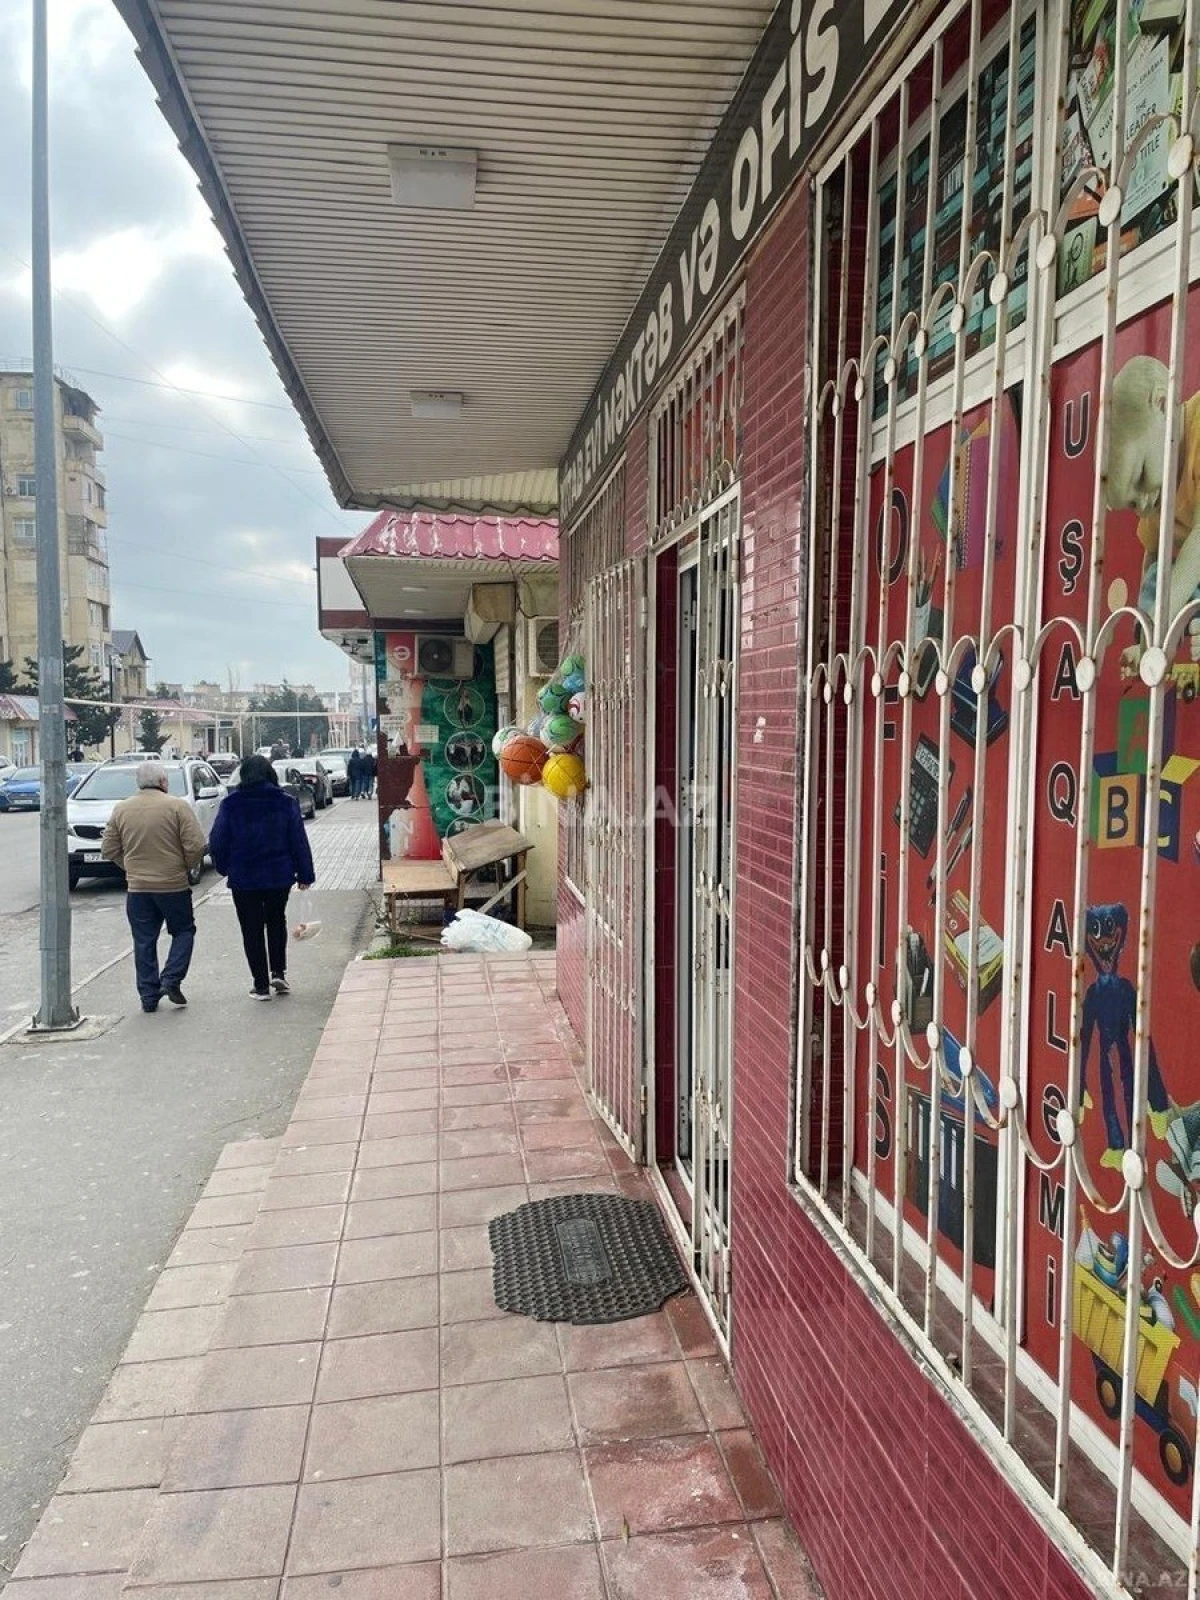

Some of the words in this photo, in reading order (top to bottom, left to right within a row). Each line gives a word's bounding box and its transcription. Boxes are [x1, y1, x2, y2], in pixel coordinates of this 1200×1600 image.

[1126, 103, 1157, 139] LEADER
[1140, 134, 1160, 161] TITLE
[1106, 784, 1130, 840] B
